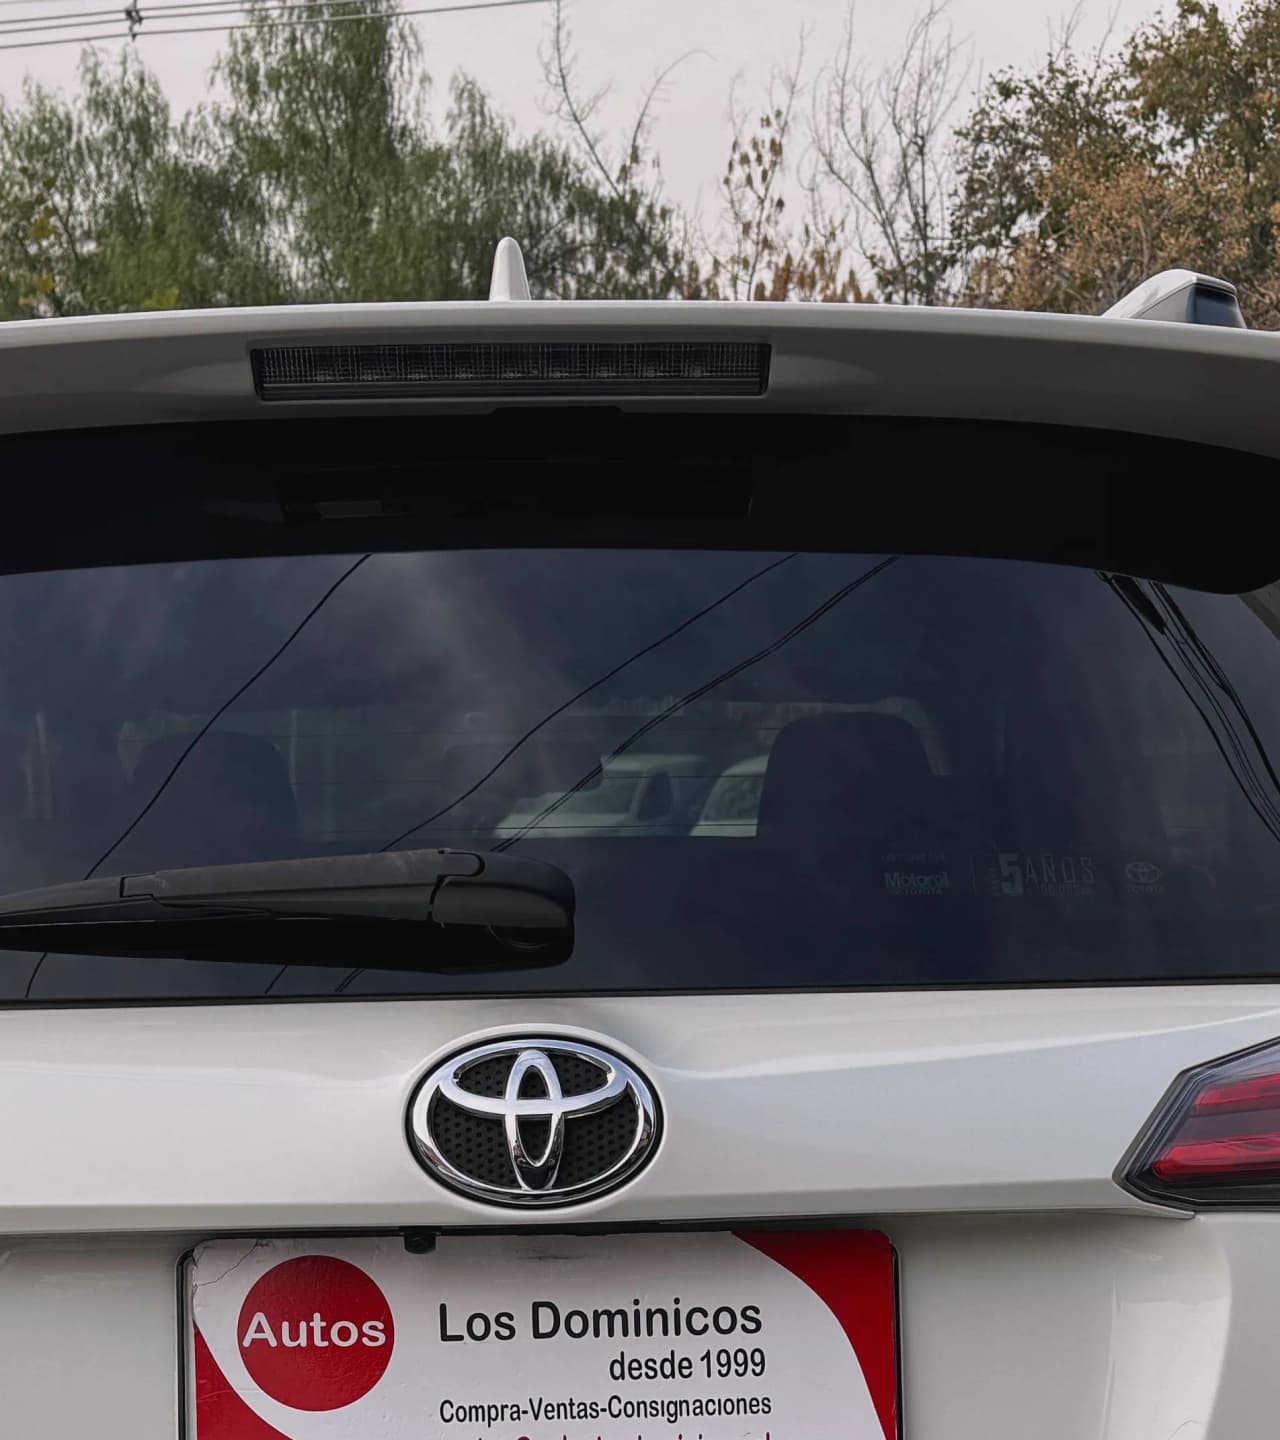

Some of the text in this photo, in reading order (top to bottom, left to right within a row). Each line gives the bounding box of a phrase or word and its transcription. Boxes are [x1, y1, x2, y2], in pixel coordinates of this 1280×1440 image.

[241, 1311, 386, 1349] Autos
[439, 1297, 763, 1342] Los Dominicos
[609, 1347, 766, 1382] desde 1999
